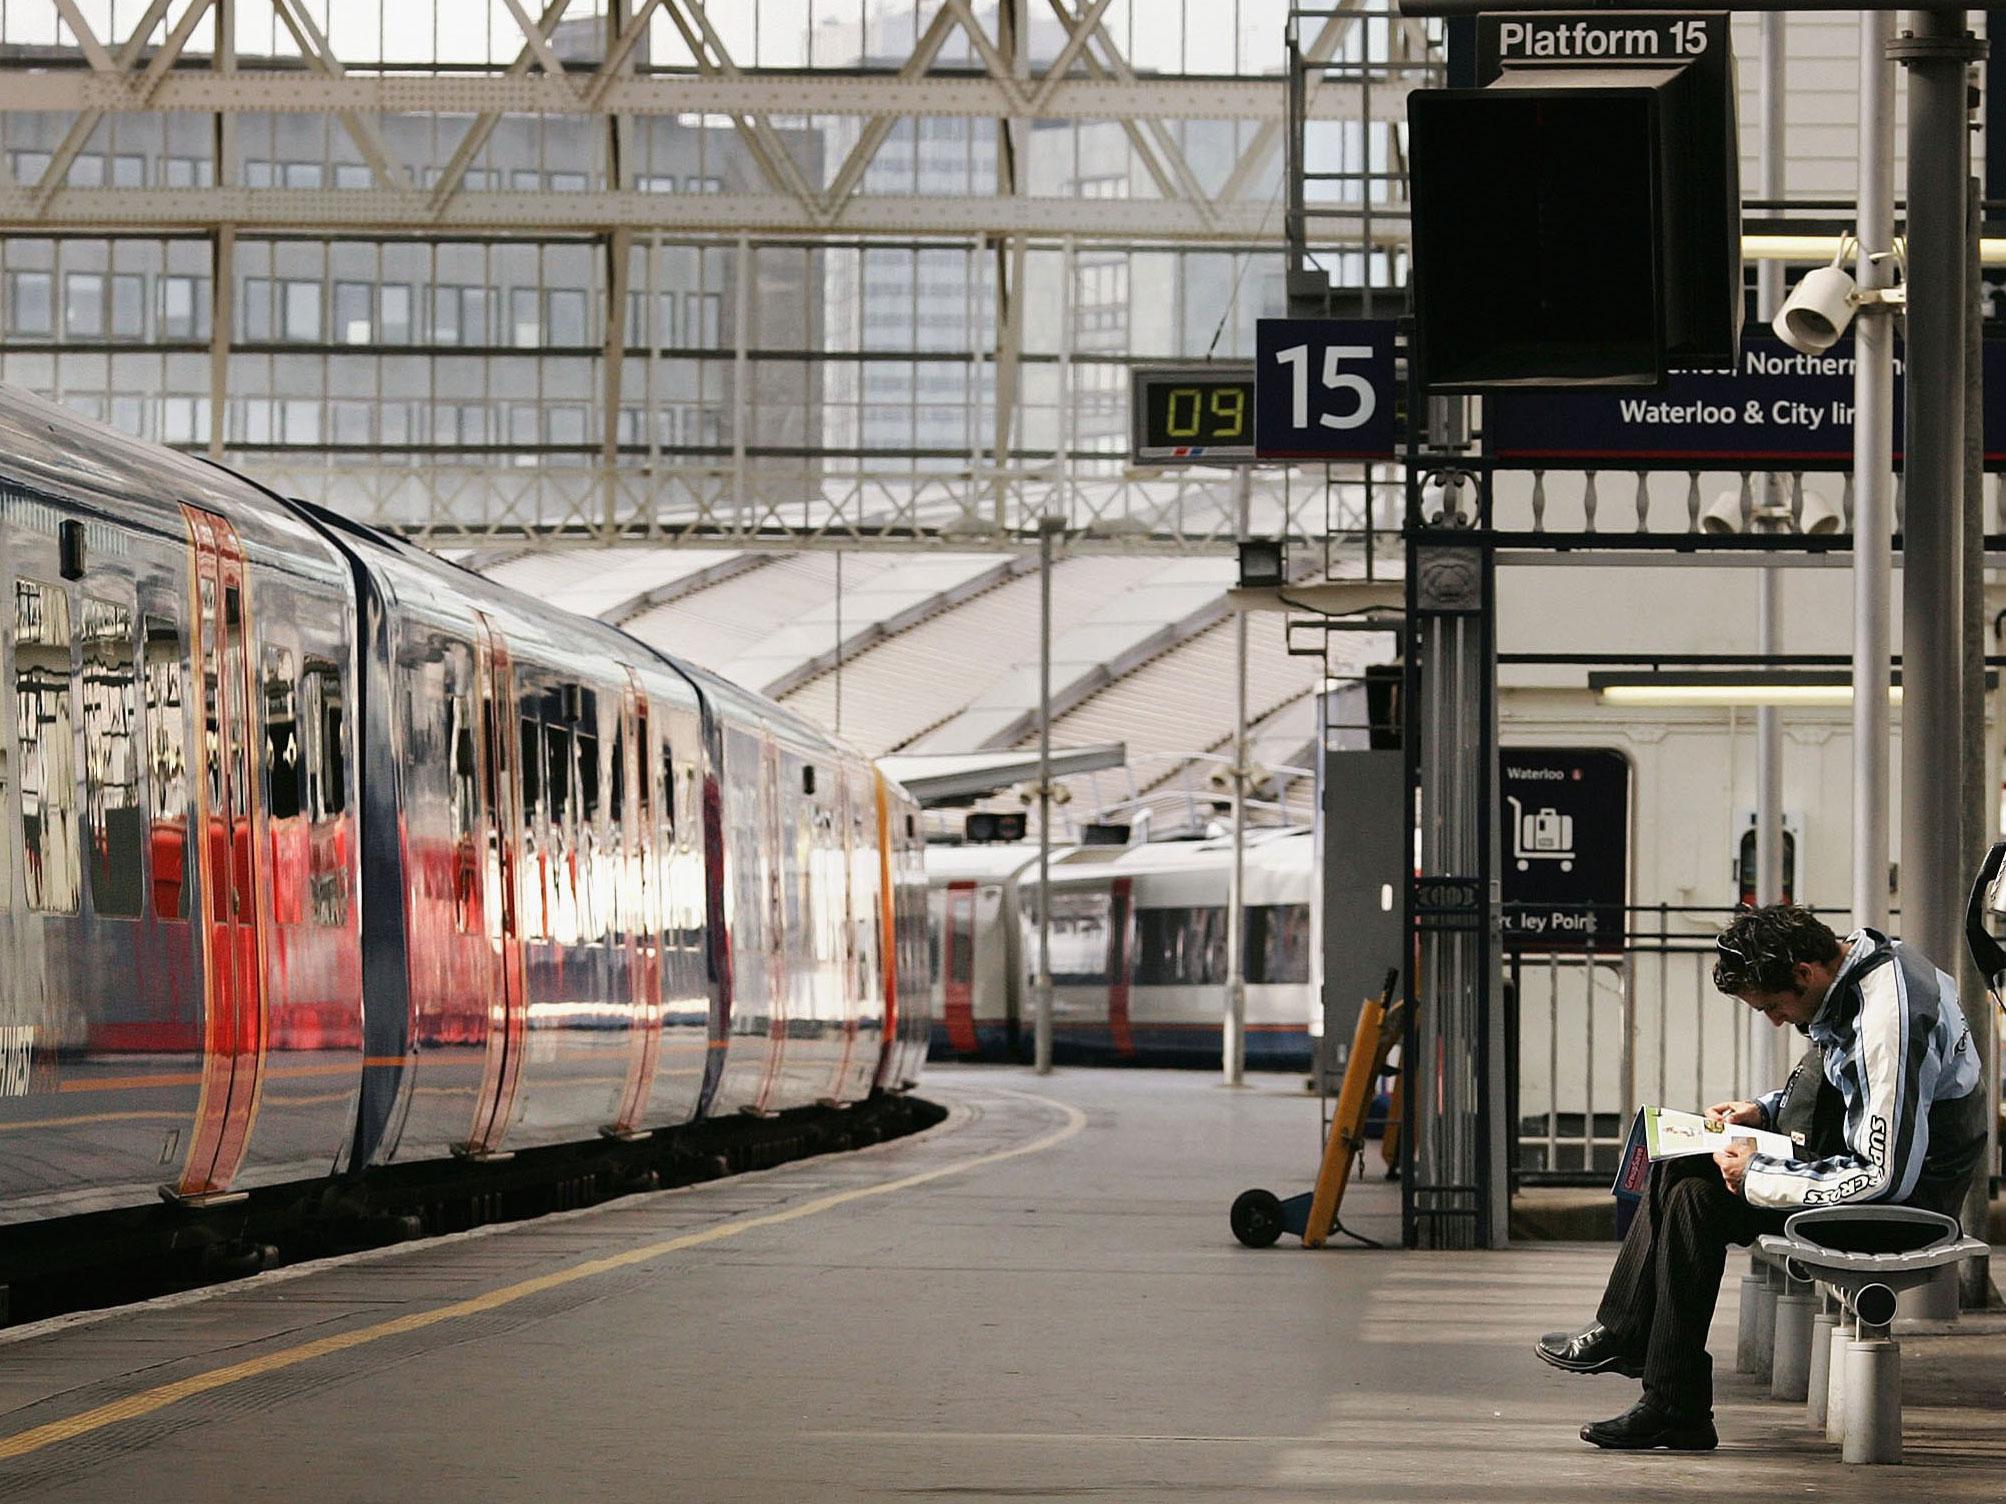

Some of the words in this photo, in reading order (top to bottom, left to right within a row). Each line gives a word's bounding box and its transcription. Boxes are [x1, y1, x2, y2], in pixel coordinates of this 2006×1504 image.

[1500, 22, 1659, 55] Platform
[1669, 20, 1708, 54] 15
[1275, 344, 1376, 430] 15
[1167, 388, 1244, 437] 09
[1619, 400, 1737, 424] Waterloo
[1743, 400, 1765, 424] &
[1772, 400, 1825, 430] City
[1831, 400, 1856, 424] lin
[1507, 766, 1565, 780] Waterloo
